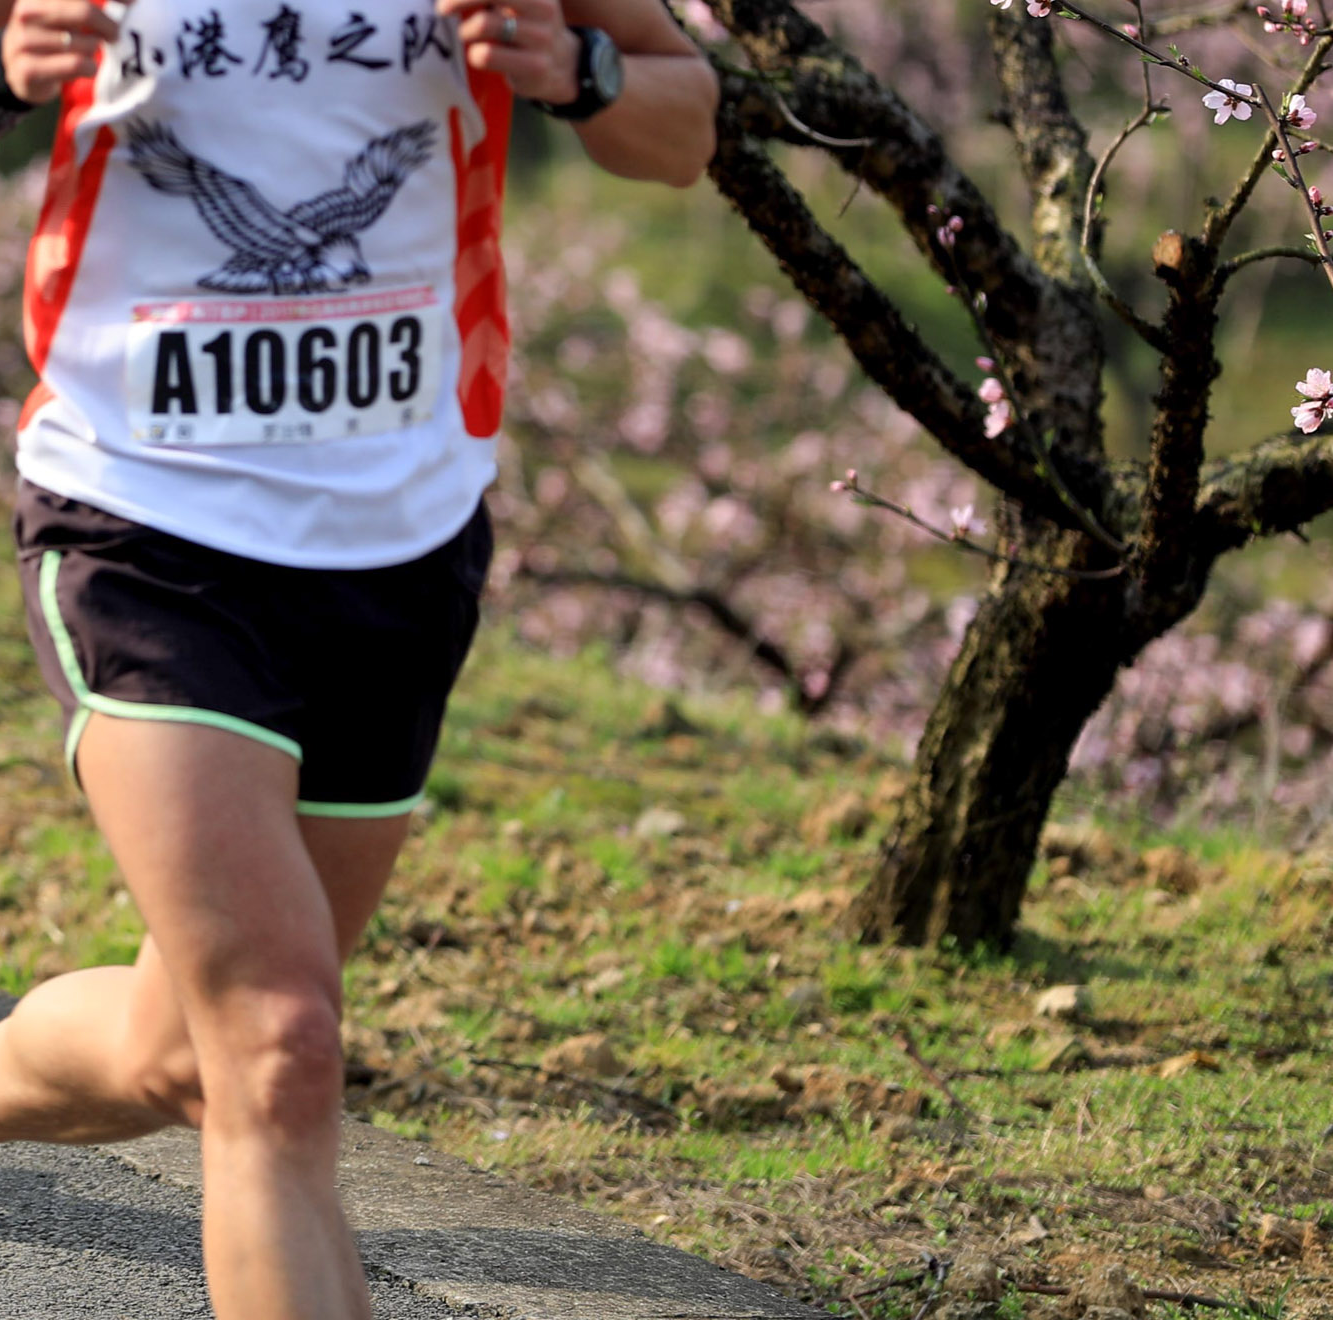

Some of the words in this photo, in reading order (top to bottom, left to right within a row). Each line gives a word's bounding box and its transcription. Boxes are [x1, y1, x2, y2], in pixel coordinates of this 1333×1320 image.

[121, 2, 452, 84] 小港鹰之队
[150, 315, 424, 416] A10603
